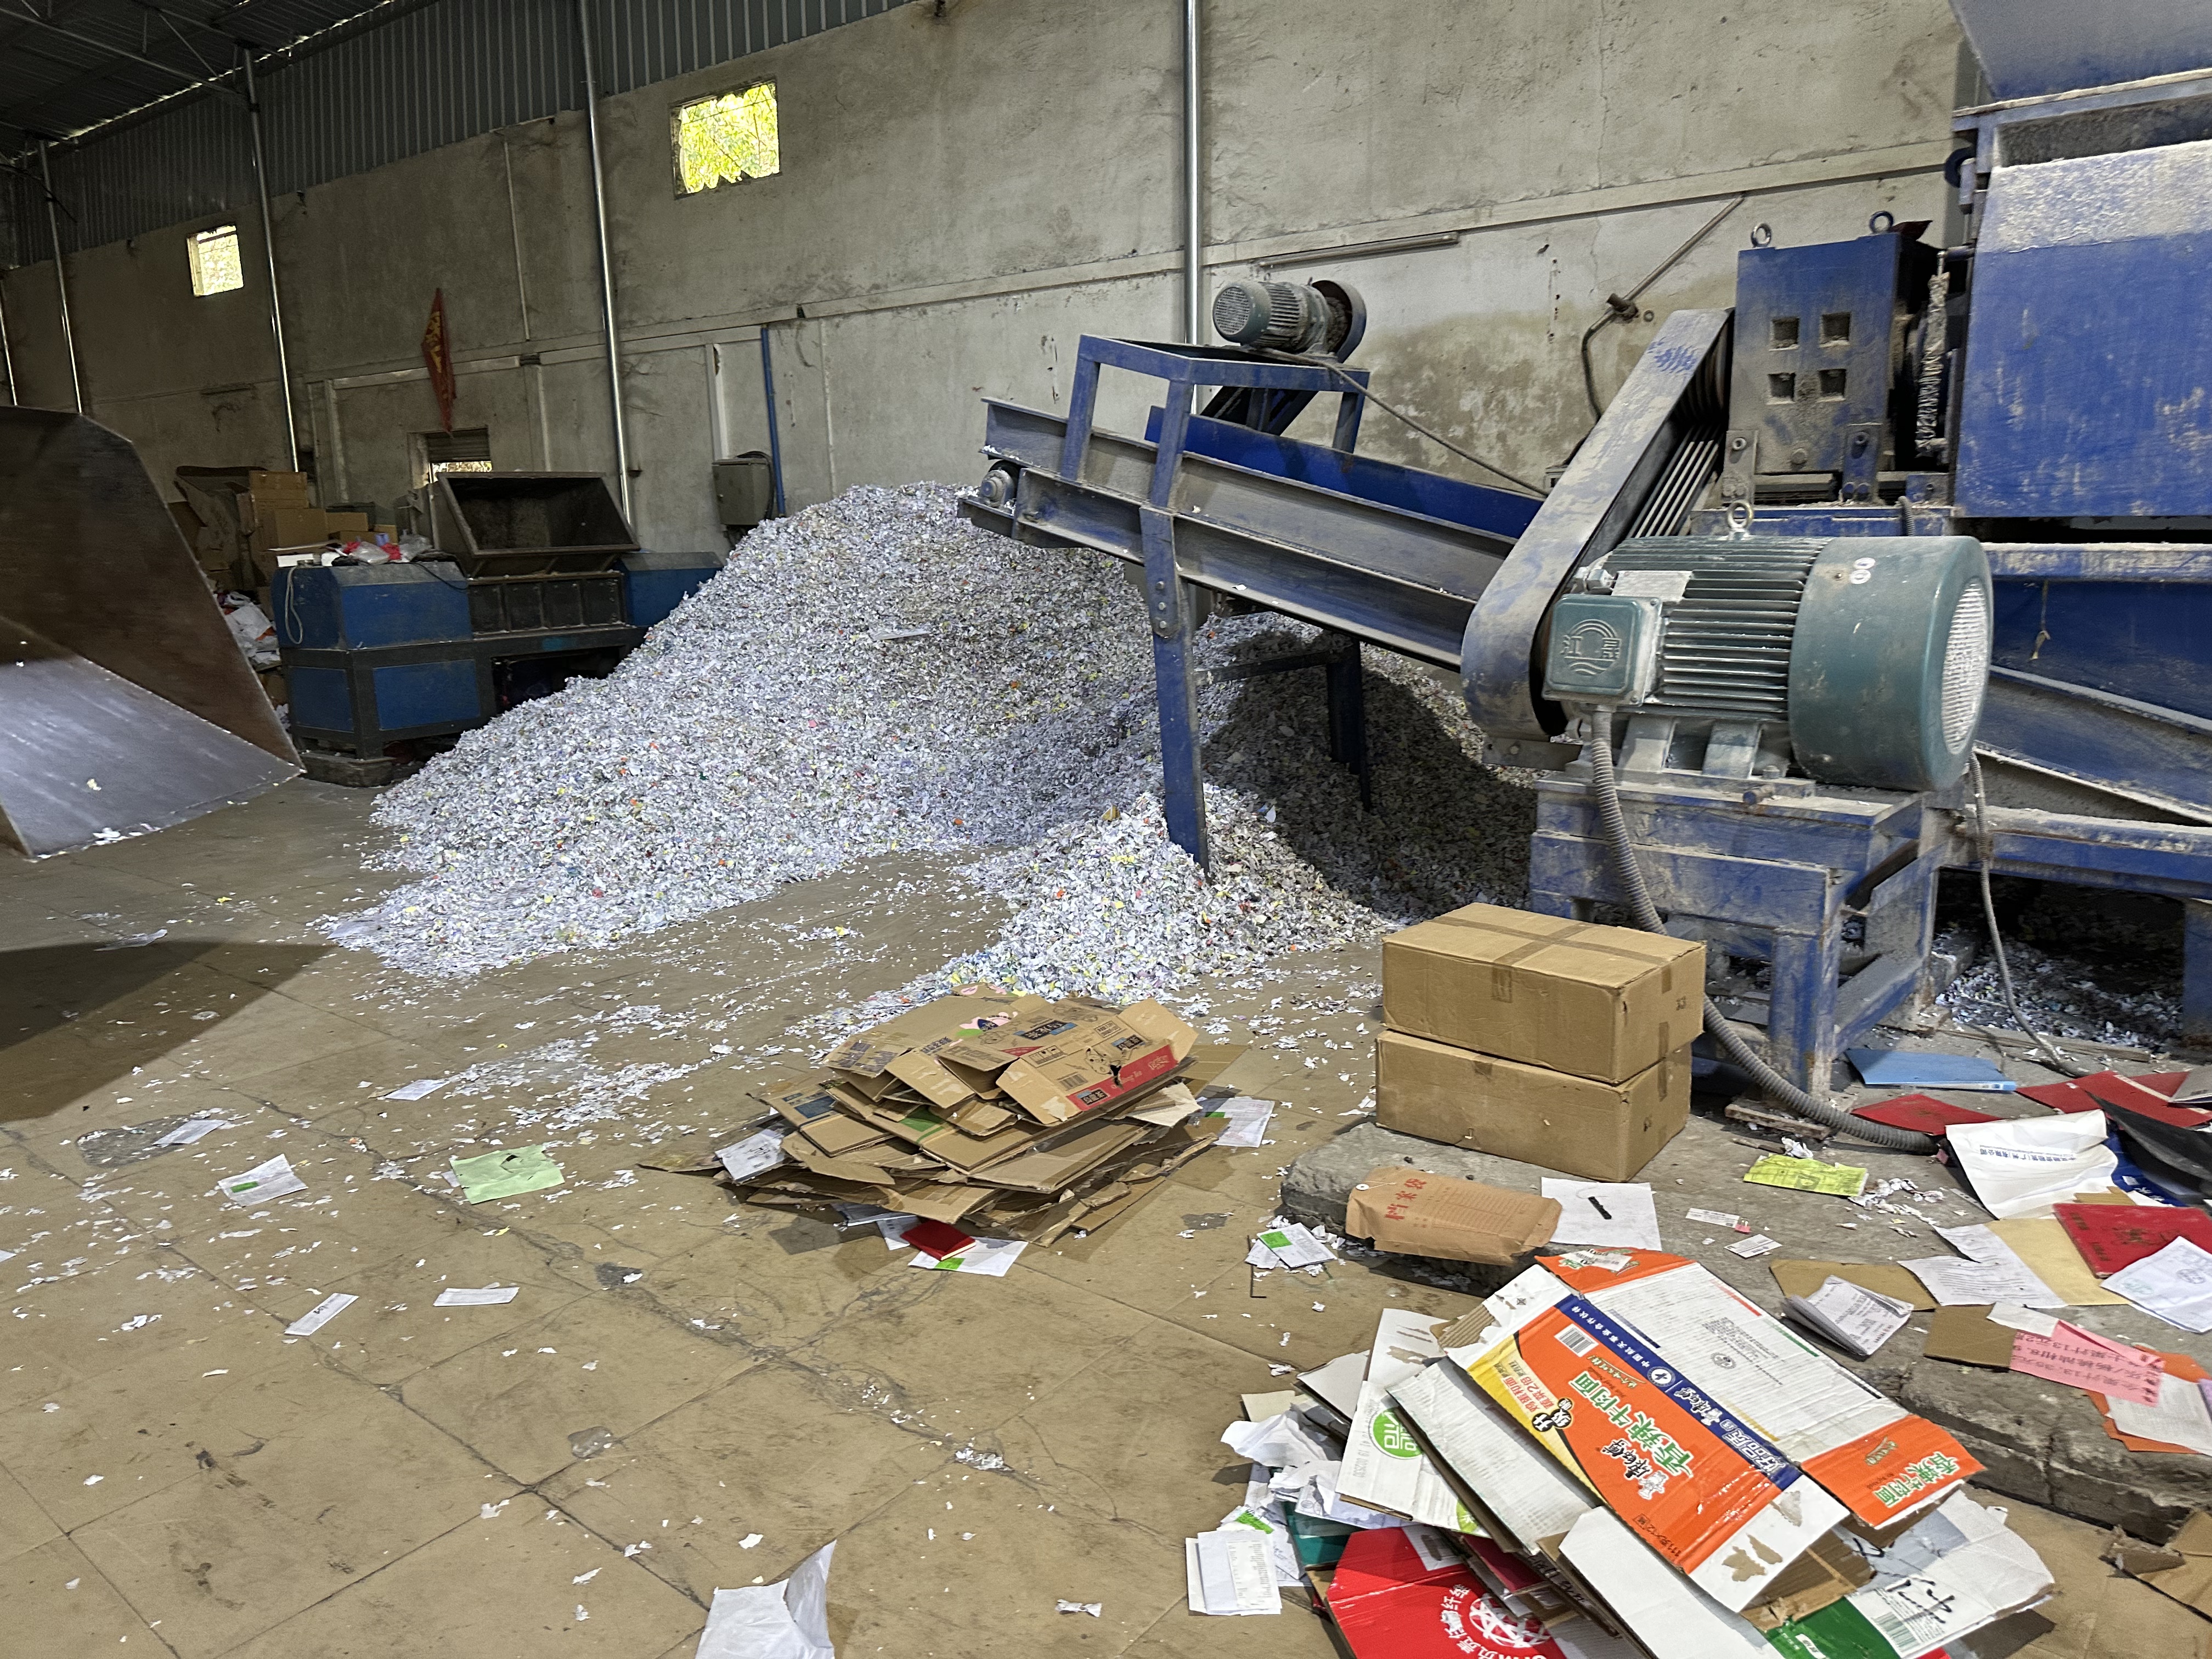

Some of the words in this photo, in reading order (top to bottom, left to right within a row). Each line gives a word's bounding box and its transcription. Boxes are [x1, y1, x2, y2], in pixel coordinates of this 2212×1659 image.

[1571, 1371, 1691, 1474] 香辣牛肉面
[1724, 1429, 1784, 1474] 好品质
[1874, 1452, 1955, 1506] 香辣牛肉面
